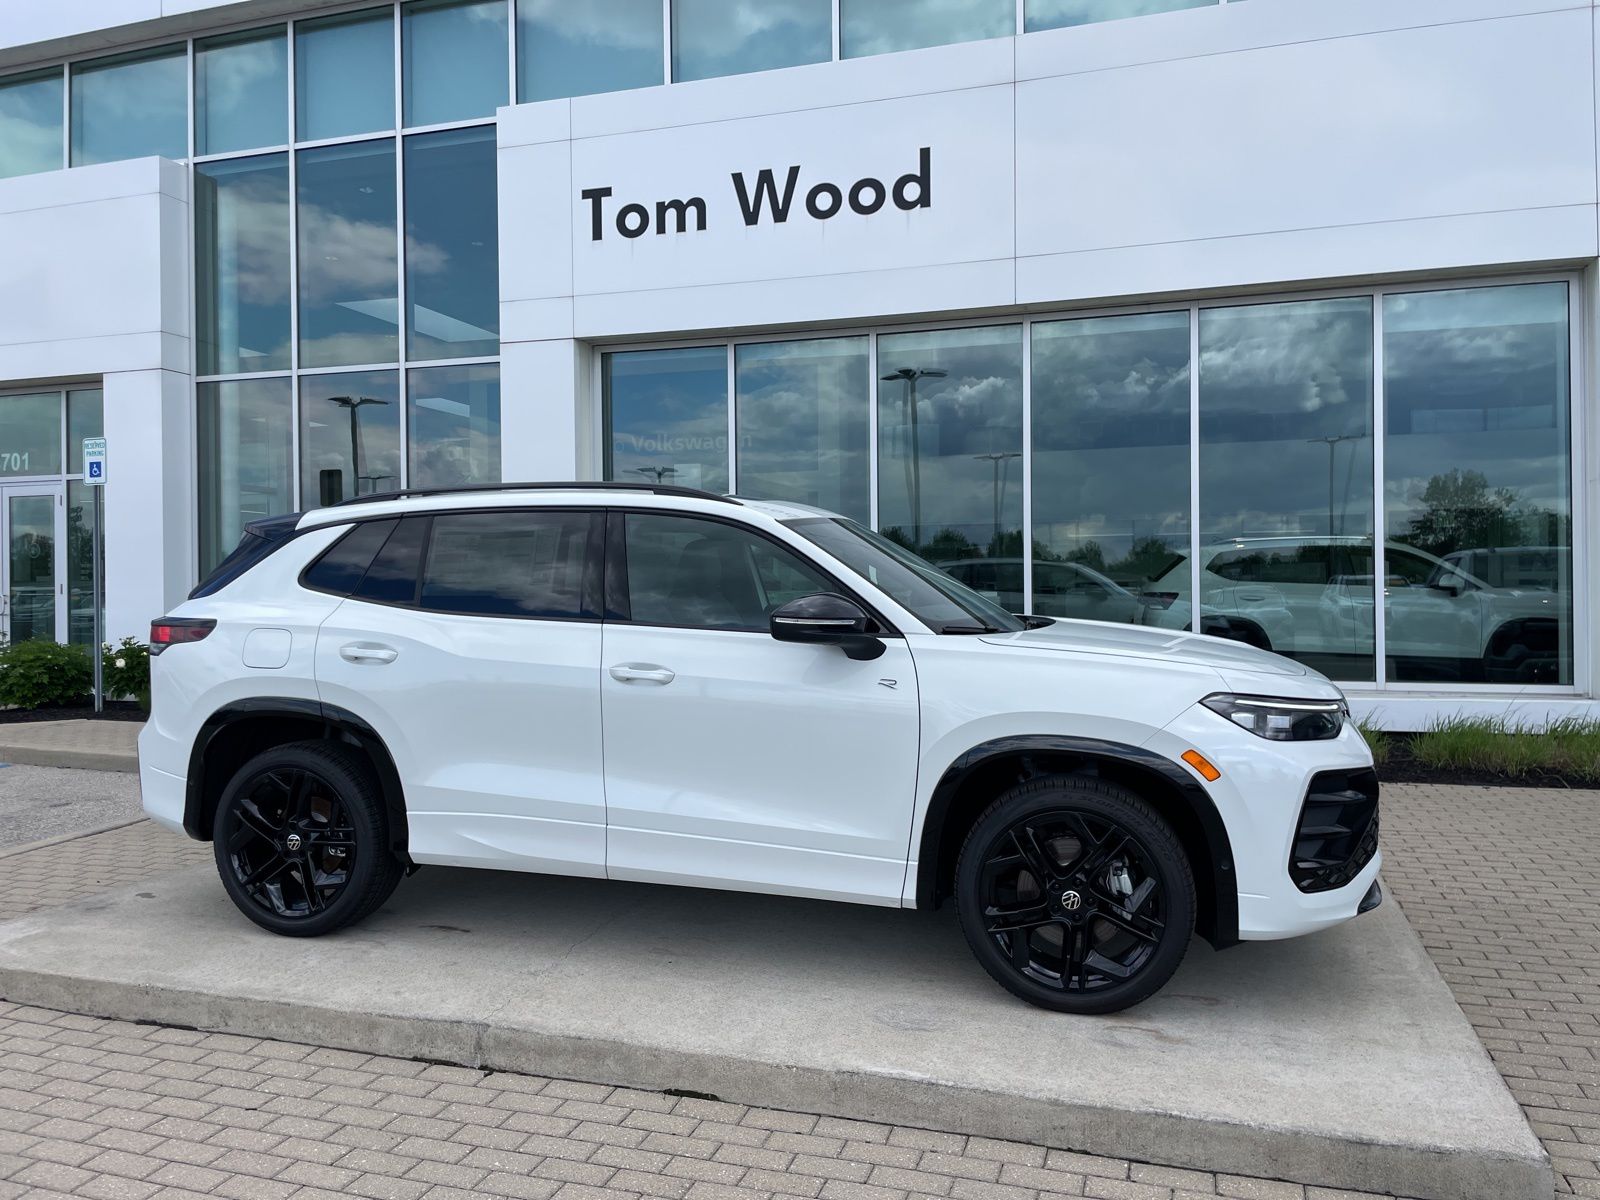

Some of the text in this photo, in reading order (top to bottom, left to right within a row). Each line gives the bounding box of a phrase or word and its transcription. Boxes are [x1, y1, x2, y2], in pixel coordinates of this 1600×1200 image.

[581, 147, 931, 241] Tom Wood
[85, 441, 105, 449] RESERVED
[630, 432, 753, 454] Volkswagn
[1, 452, 29, 471] 701
